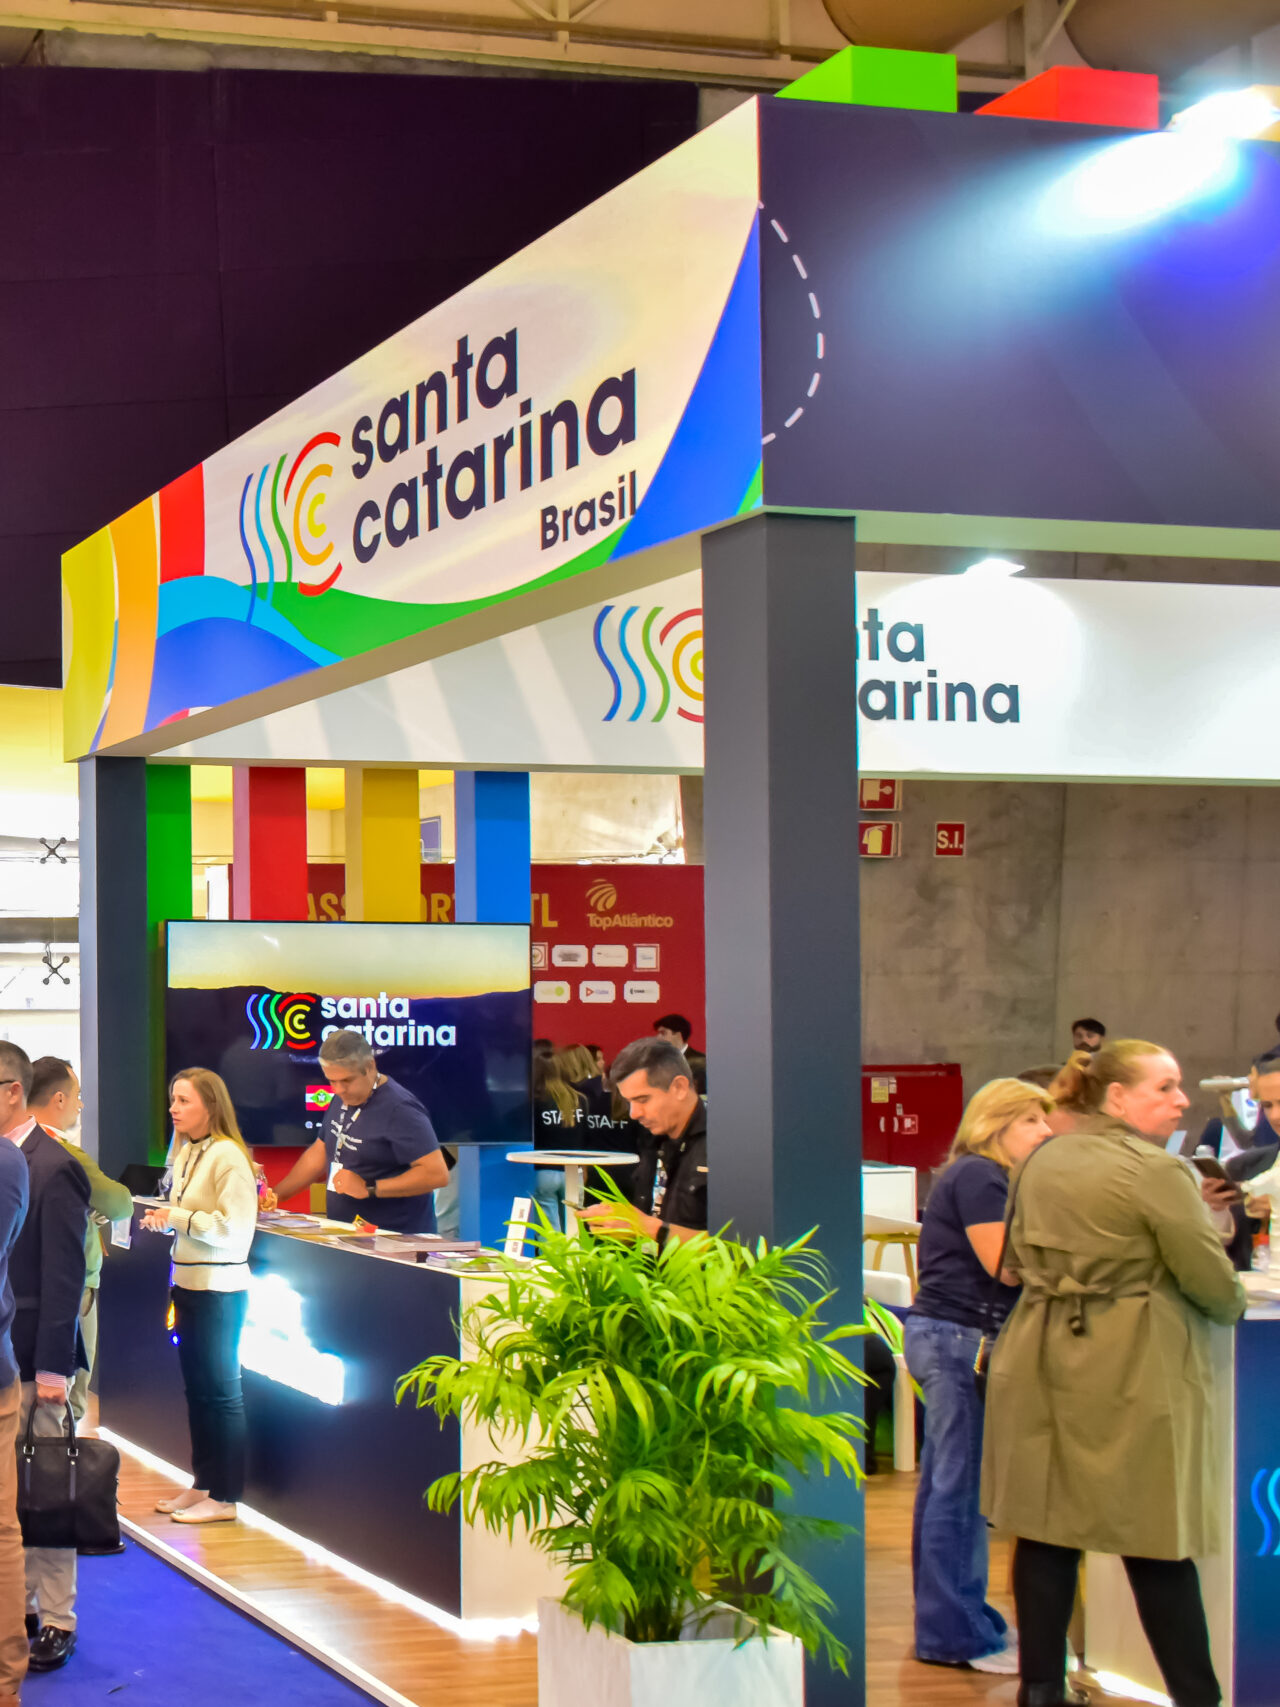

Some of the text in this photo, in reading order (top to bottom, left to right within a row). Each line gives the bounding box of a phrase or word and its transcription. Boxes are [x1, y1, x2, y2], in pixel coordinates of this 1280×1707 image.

[351, 327, 518, 480] santa
[353, 367, 636, 564] catarina
[540, 470, 637, 551] Brasil
[858, 669, 1020, 723] arina
[936, 830, 964, 849] S.I.
[586, 912, 674, 931] TopAtlântico
[321, 992, 410, 1019] santa
